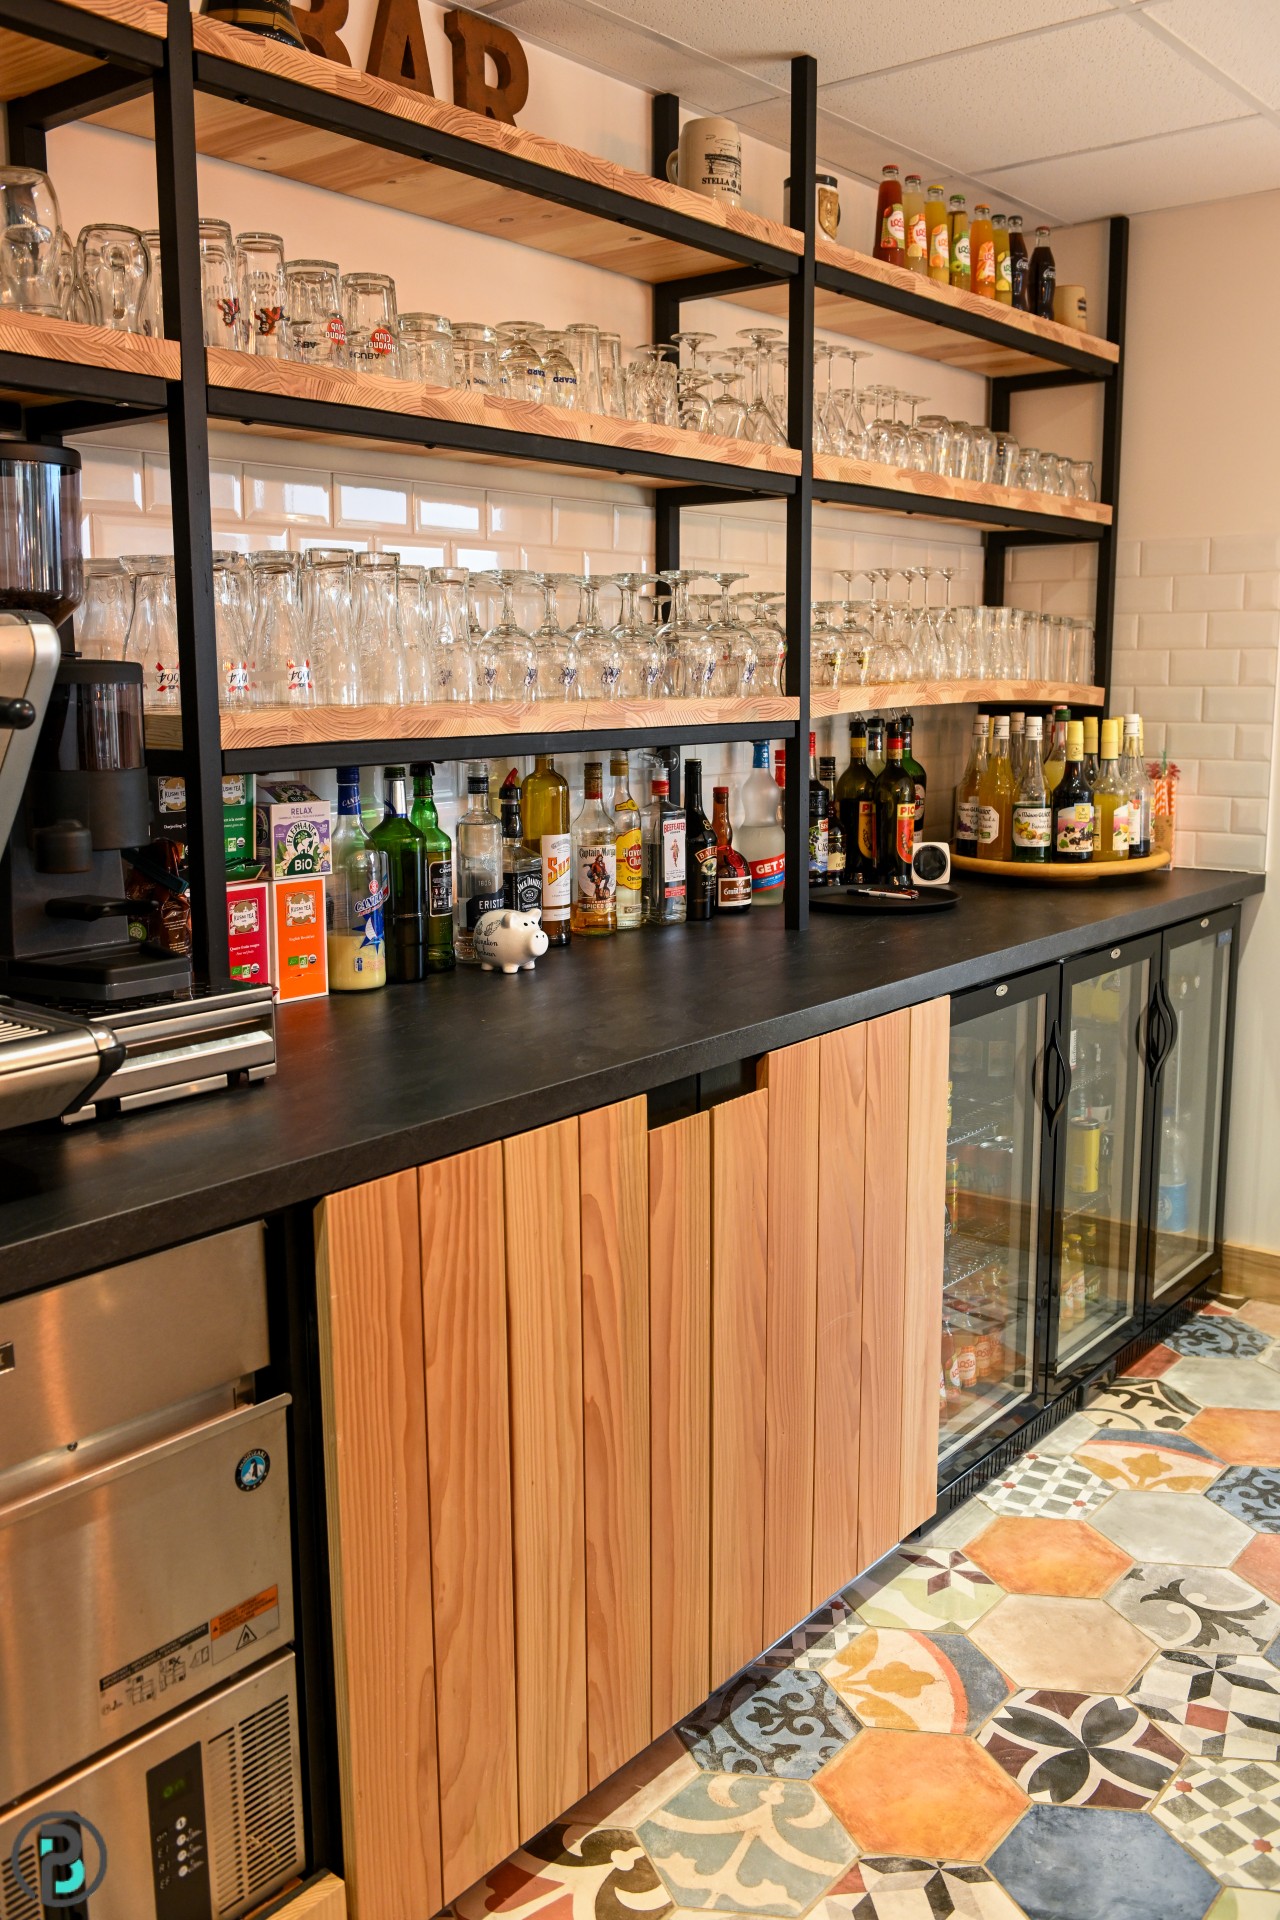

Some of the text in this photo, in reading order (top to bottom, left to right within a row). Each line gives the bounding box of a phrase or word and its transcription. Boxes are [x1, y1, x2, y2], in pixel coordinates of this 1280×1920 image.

[702, 177, 730, 186] STELLA
[374, 332, 392, 343] Club
[368, 340, 397, 354] Havana
[164, 790, 179, 798] KUSMI
[290, 806, 313, 816] RELAX
[900, 805, 915, 816] PIC
[286, 821, 316, 844] ELEPHANT
[663, 822, 686, 834] BEEFEATER
[578, 847, 601, 859] Captain
[601, 847, 616, 858] Morga
[755, 860, 779, 875] GET
[290, 905, 304, 913] KUSMI
